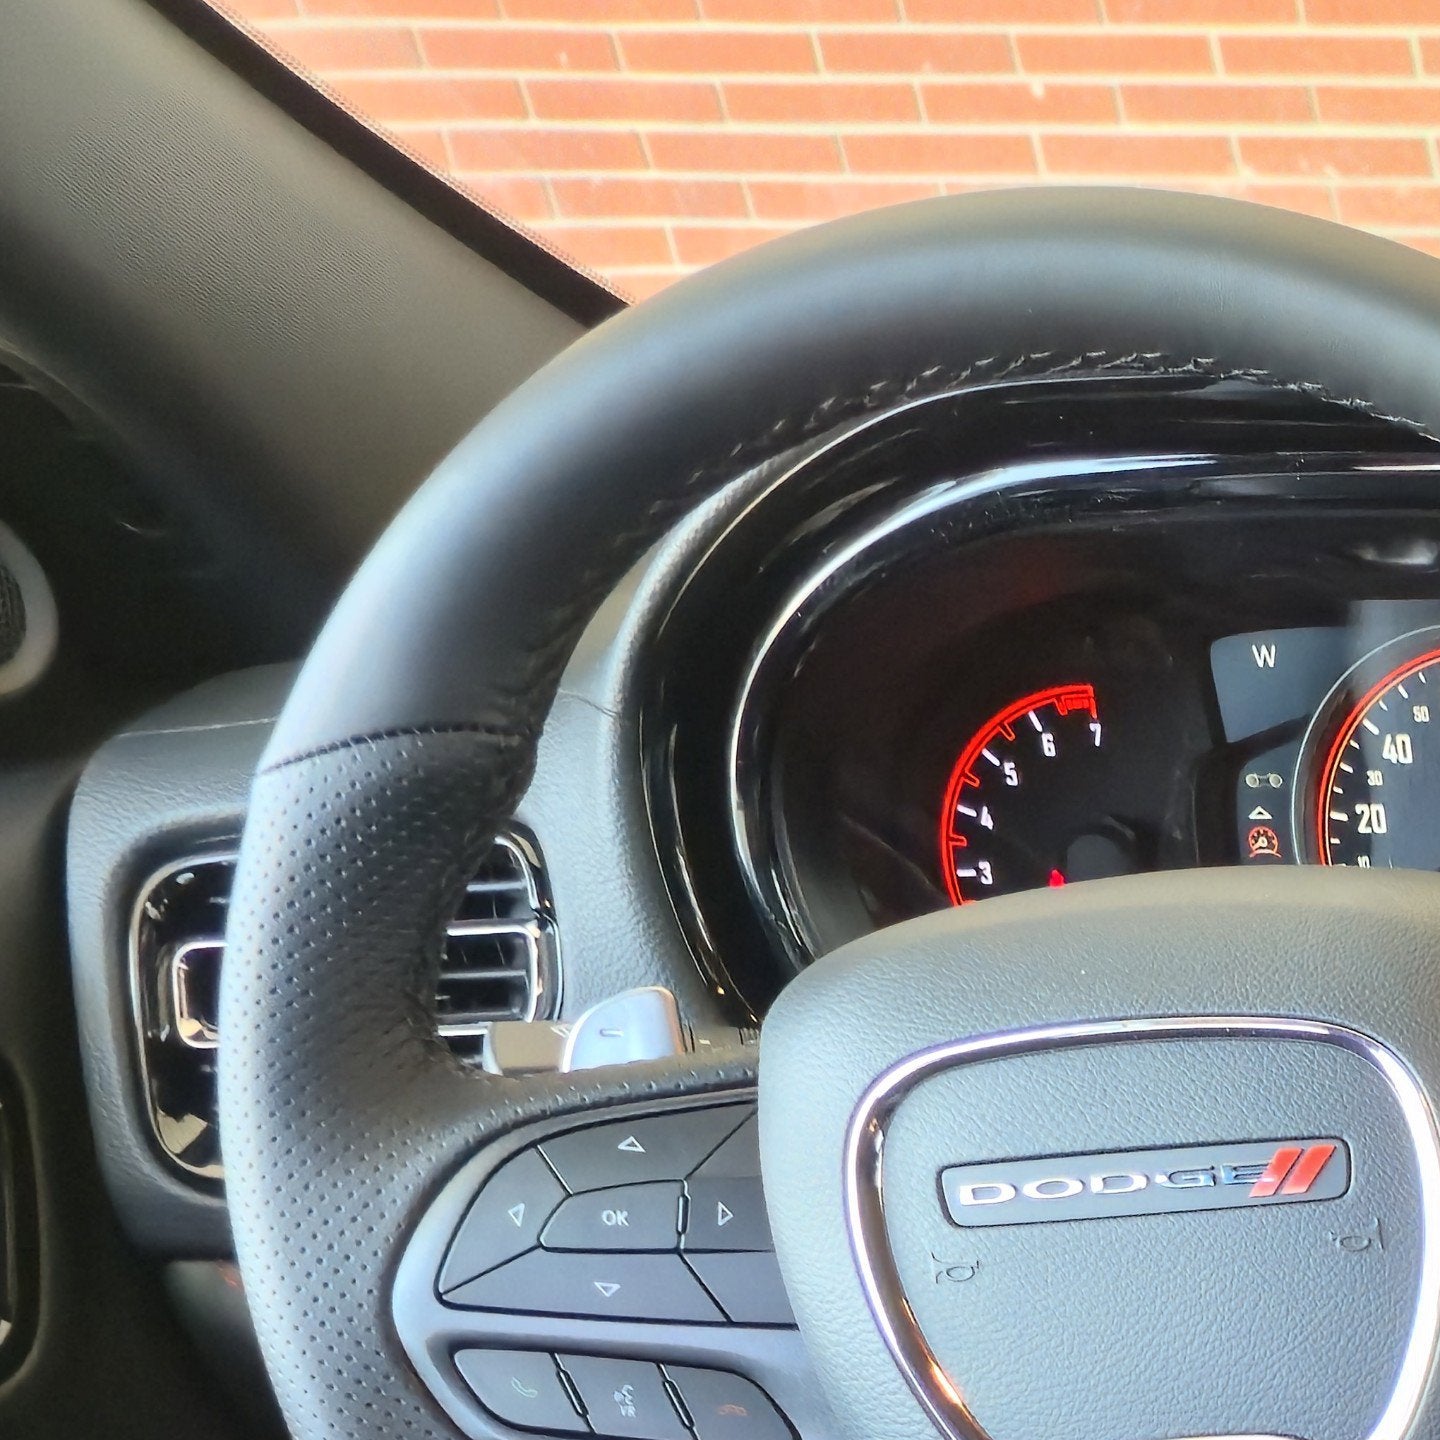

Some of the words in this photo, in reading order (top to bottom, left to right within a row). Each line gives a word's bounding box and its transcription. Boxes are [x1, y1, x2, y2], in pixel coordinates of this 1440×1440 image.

[1251, 644, 1277, 669] W
[1412, 705, 1430, 723] 50
[1041, 732, 1057, 757] 6
[1089, 722, 1102, 747] 7
[1382, 733, 1413, 764] 40
[1003, 762, 1019, 787] 5
[1366, 769, 1384, 787] 30
[980, 805, 994, 831] 4
[1355, 803, 1388, 834] 20
[977, 860, 993, 885] 3
[959, 1161, 1274, 1206] DODGE
[602, 1210, 630, 1227] OK
